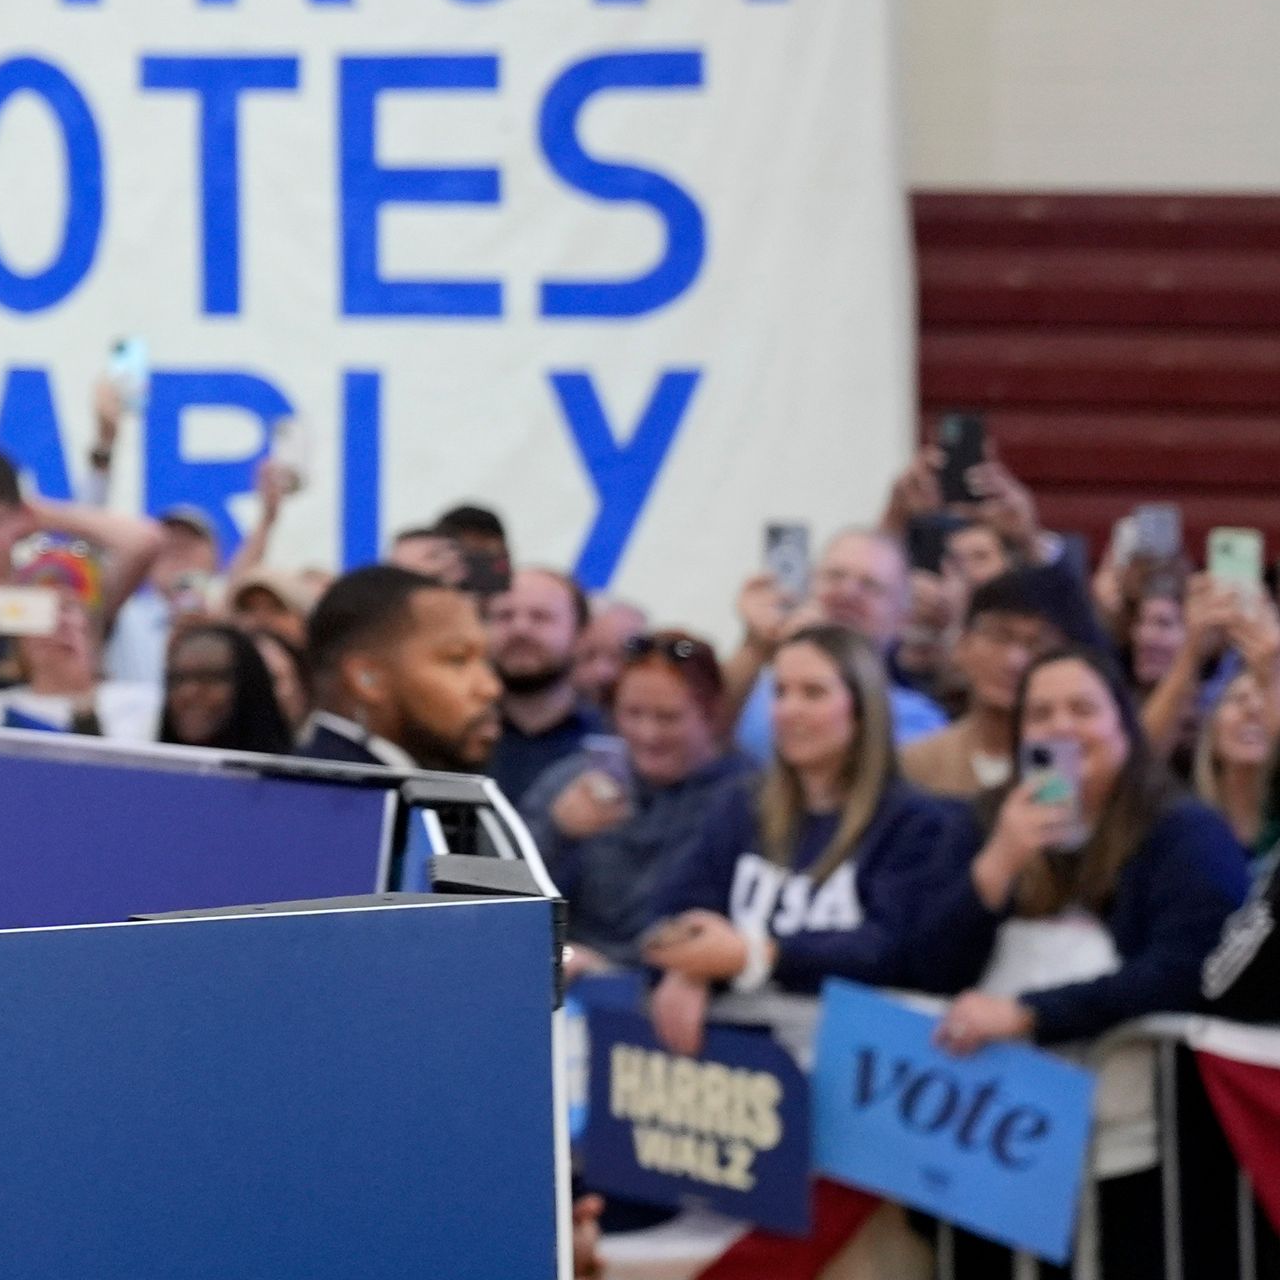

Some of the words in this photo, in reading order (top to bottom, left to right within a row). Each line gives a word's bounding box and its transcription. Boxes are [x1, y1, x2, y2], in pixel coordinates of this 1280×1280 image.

[610, 1042, 783, 1150] HARRIS
[851, 1046, 1052, 1172] vote
[633, 1117, 757, 1192] WALZ
